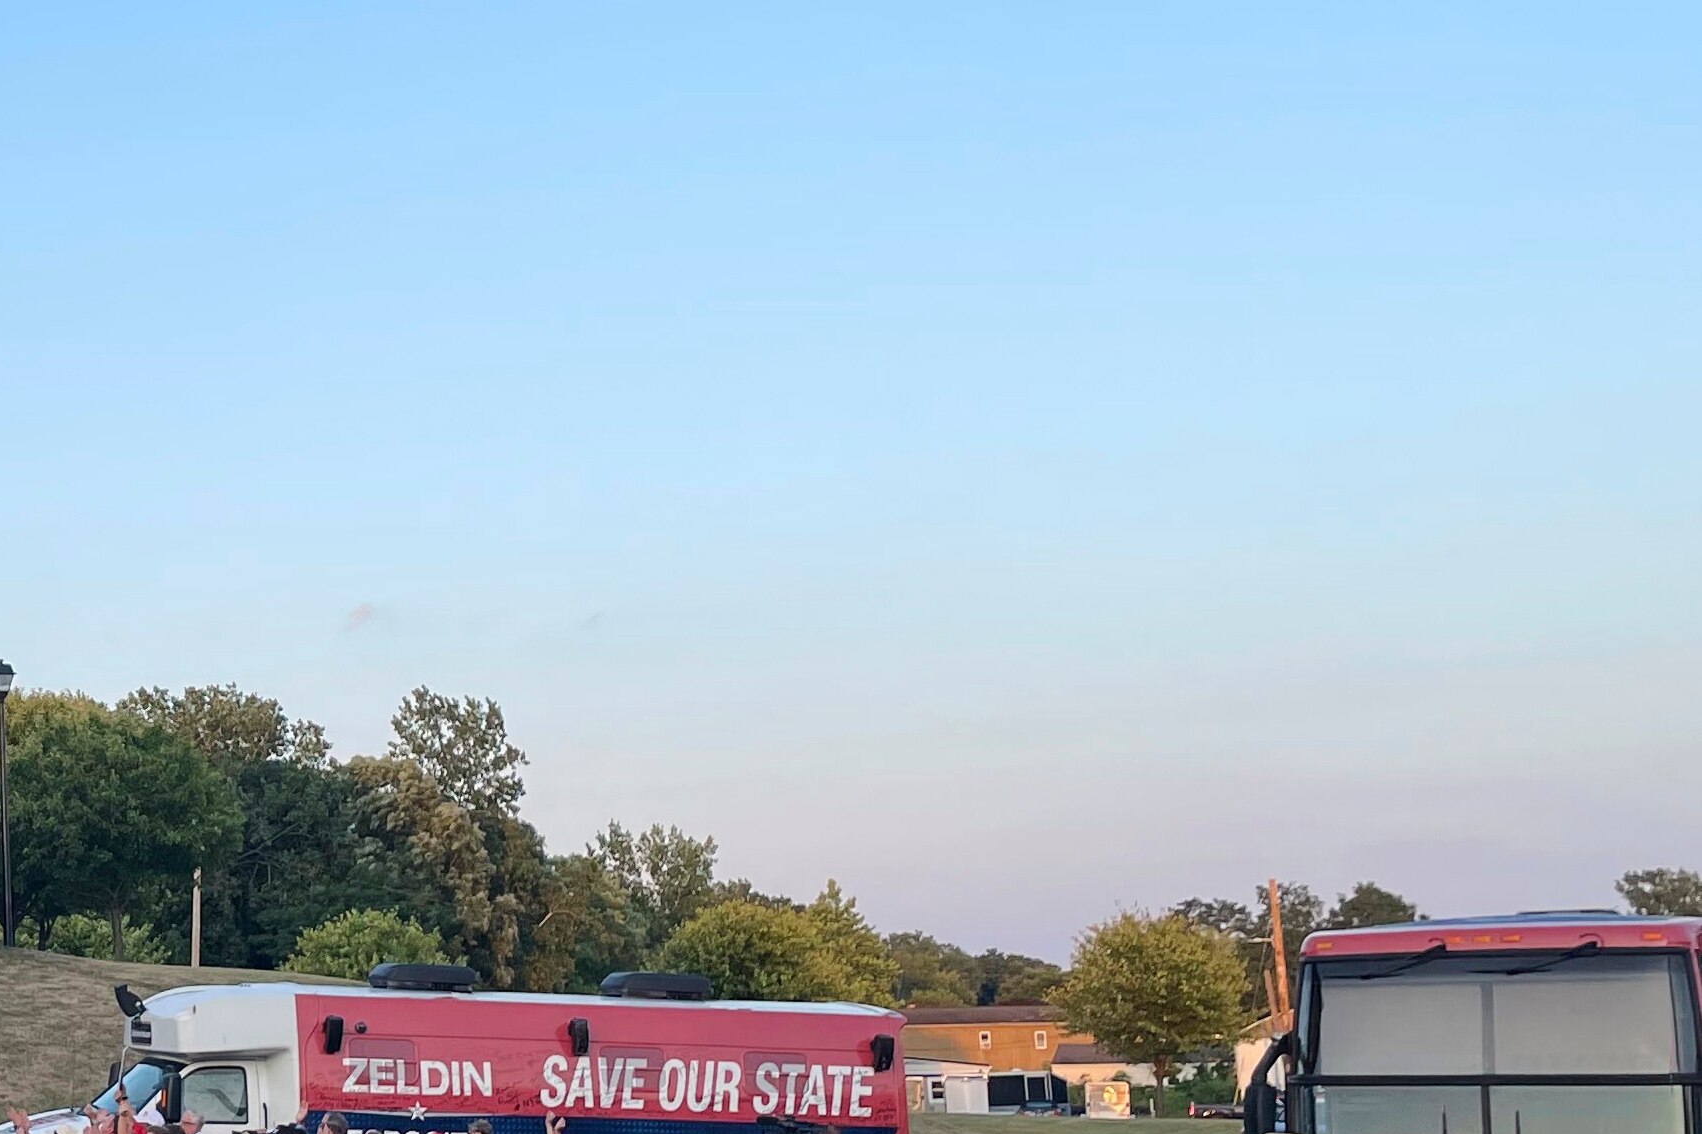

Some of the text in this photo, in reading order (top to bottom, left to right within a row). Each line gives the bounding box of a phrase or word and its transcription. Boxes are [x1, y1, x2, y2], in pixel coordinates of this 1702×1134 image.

[342, 1057, 493, 1097] ZELDIN
[540, 1054, 648, 1109] SAVE
[658, 1058, 742, 1114] OUR
[753, 1062, 875, 1118] STATE
